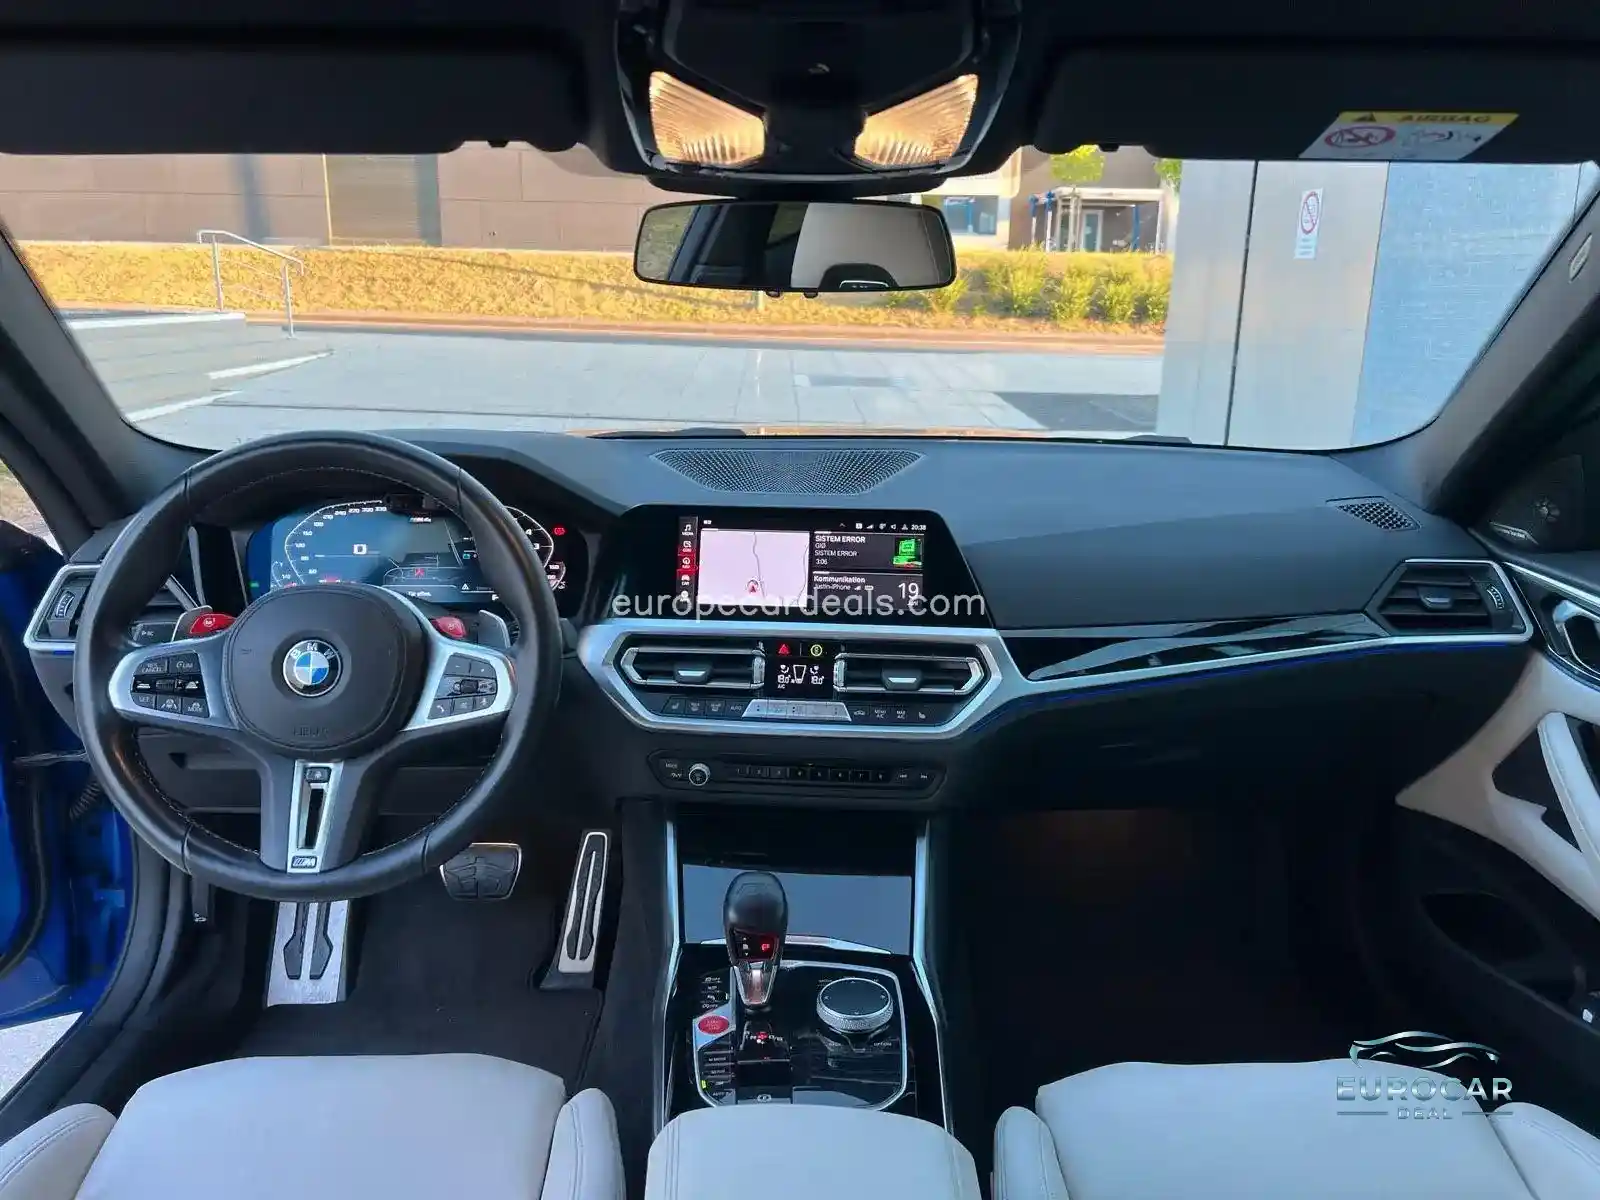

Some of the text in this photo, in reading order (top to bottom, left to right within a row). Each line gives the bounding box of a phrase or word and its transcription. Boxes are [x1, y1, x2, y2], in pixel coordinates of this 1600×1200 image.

[815, 535, 841, 543] SISTEM
[813, 575, 866, 583] Kommunikation
[898, 582, 919, 599] 19
